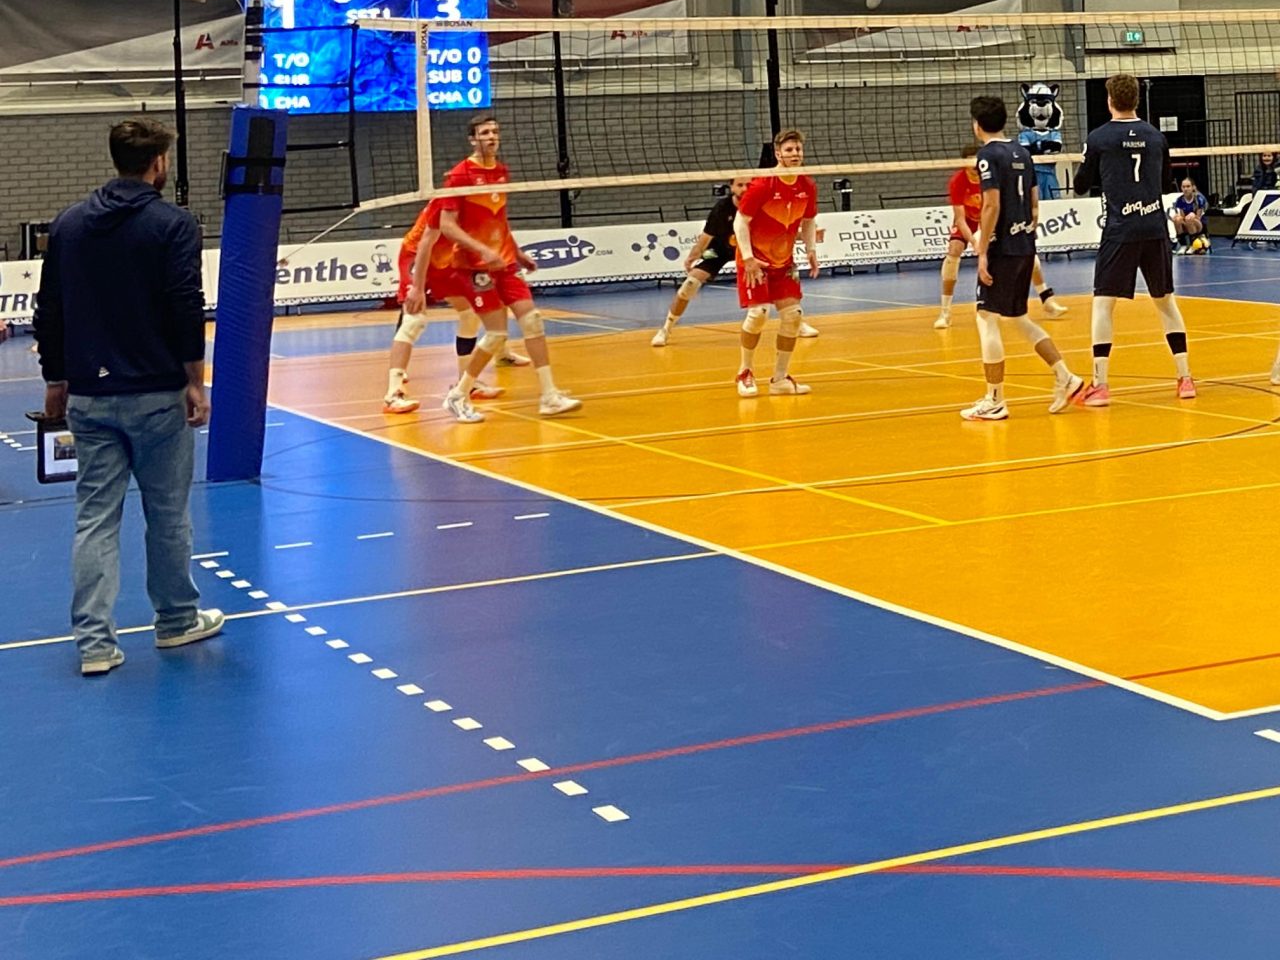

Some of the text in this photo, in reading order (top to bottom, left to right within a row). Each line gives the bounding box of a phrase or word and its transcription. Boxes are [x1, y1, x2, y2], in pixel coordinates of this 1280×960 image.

[467, 47, 481, 64] 0
[428, 67, 481, 84] SUB 0
[467, 88, 482, 105] 0
[1131, 153, 1141, 182] 7
[839, 229, 898, 242] POUW
[850, 241, 891, 251] RENT
